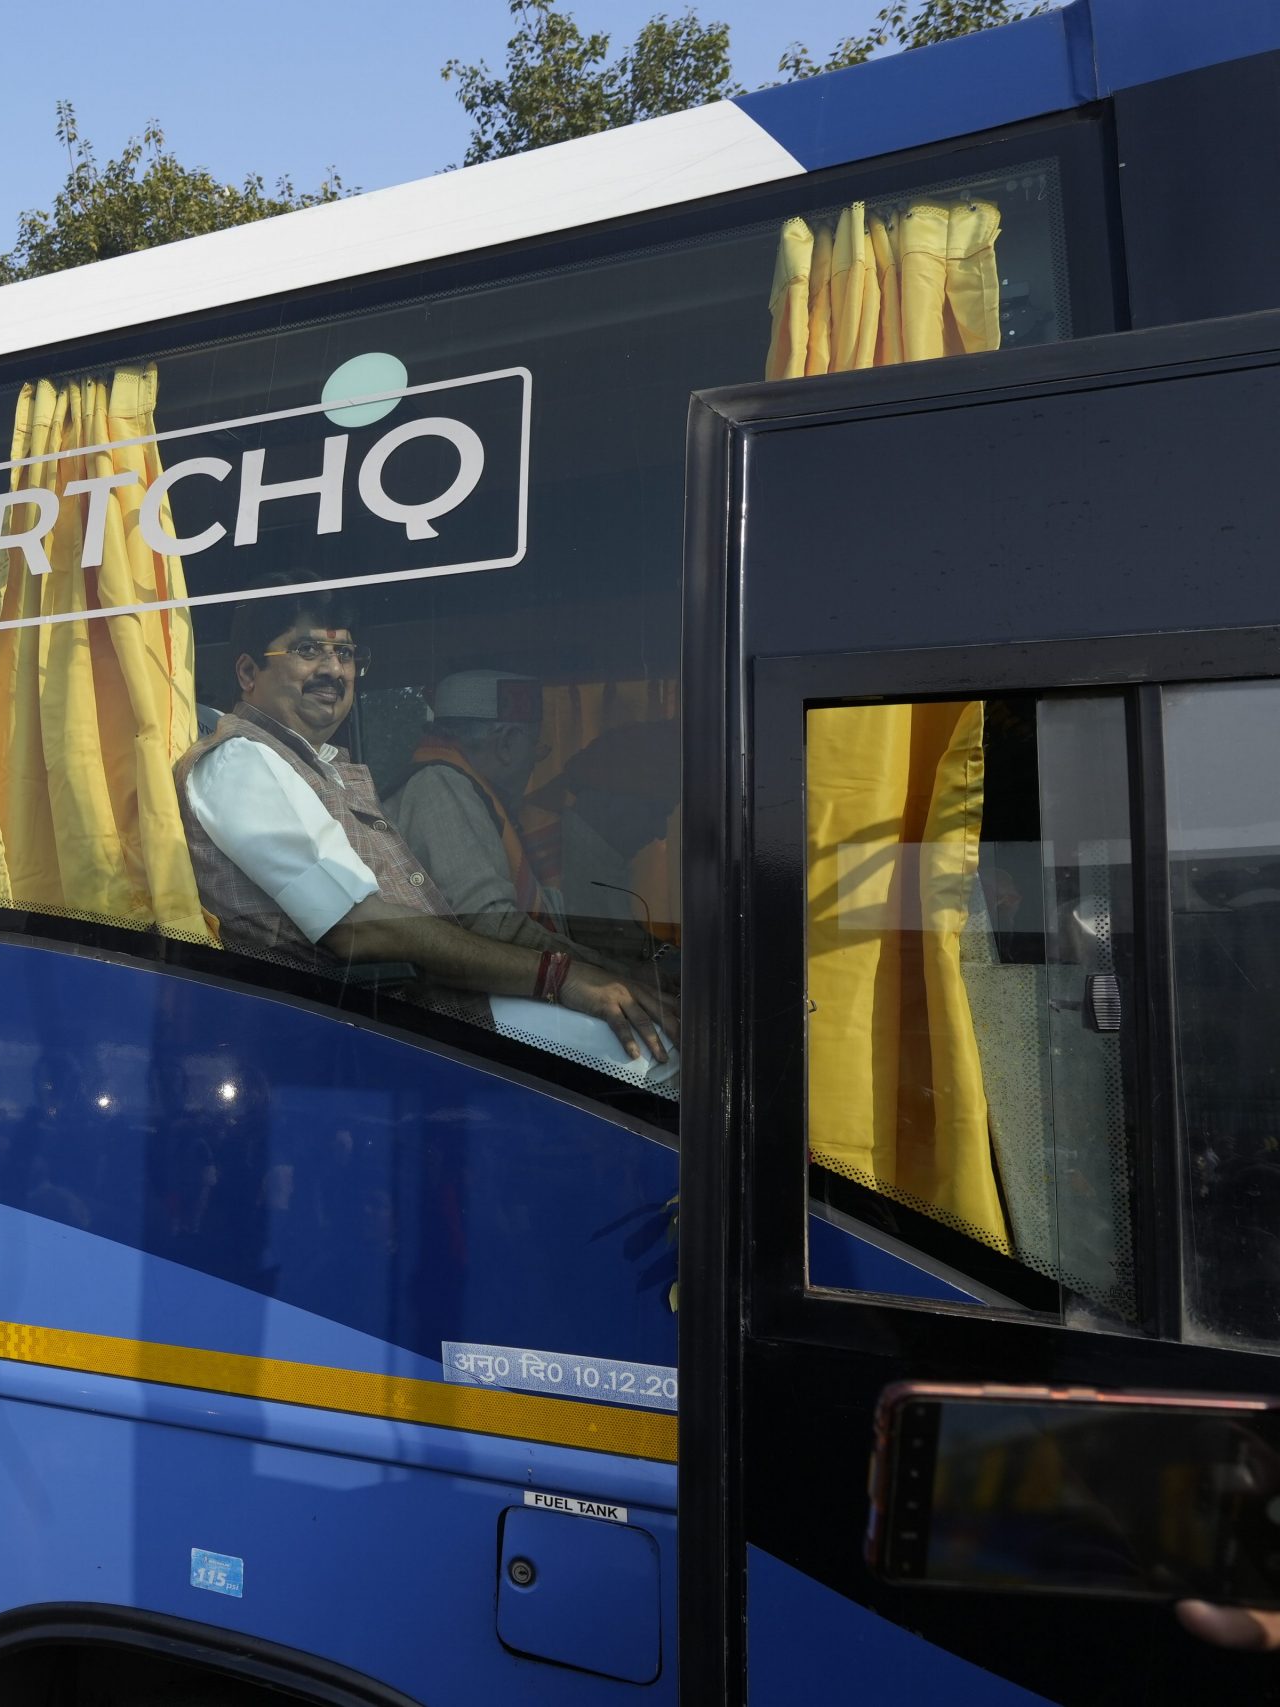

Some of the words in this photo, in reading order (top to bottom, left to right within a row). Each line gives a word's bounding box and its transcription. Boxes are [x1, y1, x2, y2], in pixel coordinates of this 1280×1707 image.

[535, 1494, 573, 1511] FUEL
[577, 1502, 618, 1519] TANK
[197, 1567, 227, 1587] 115
